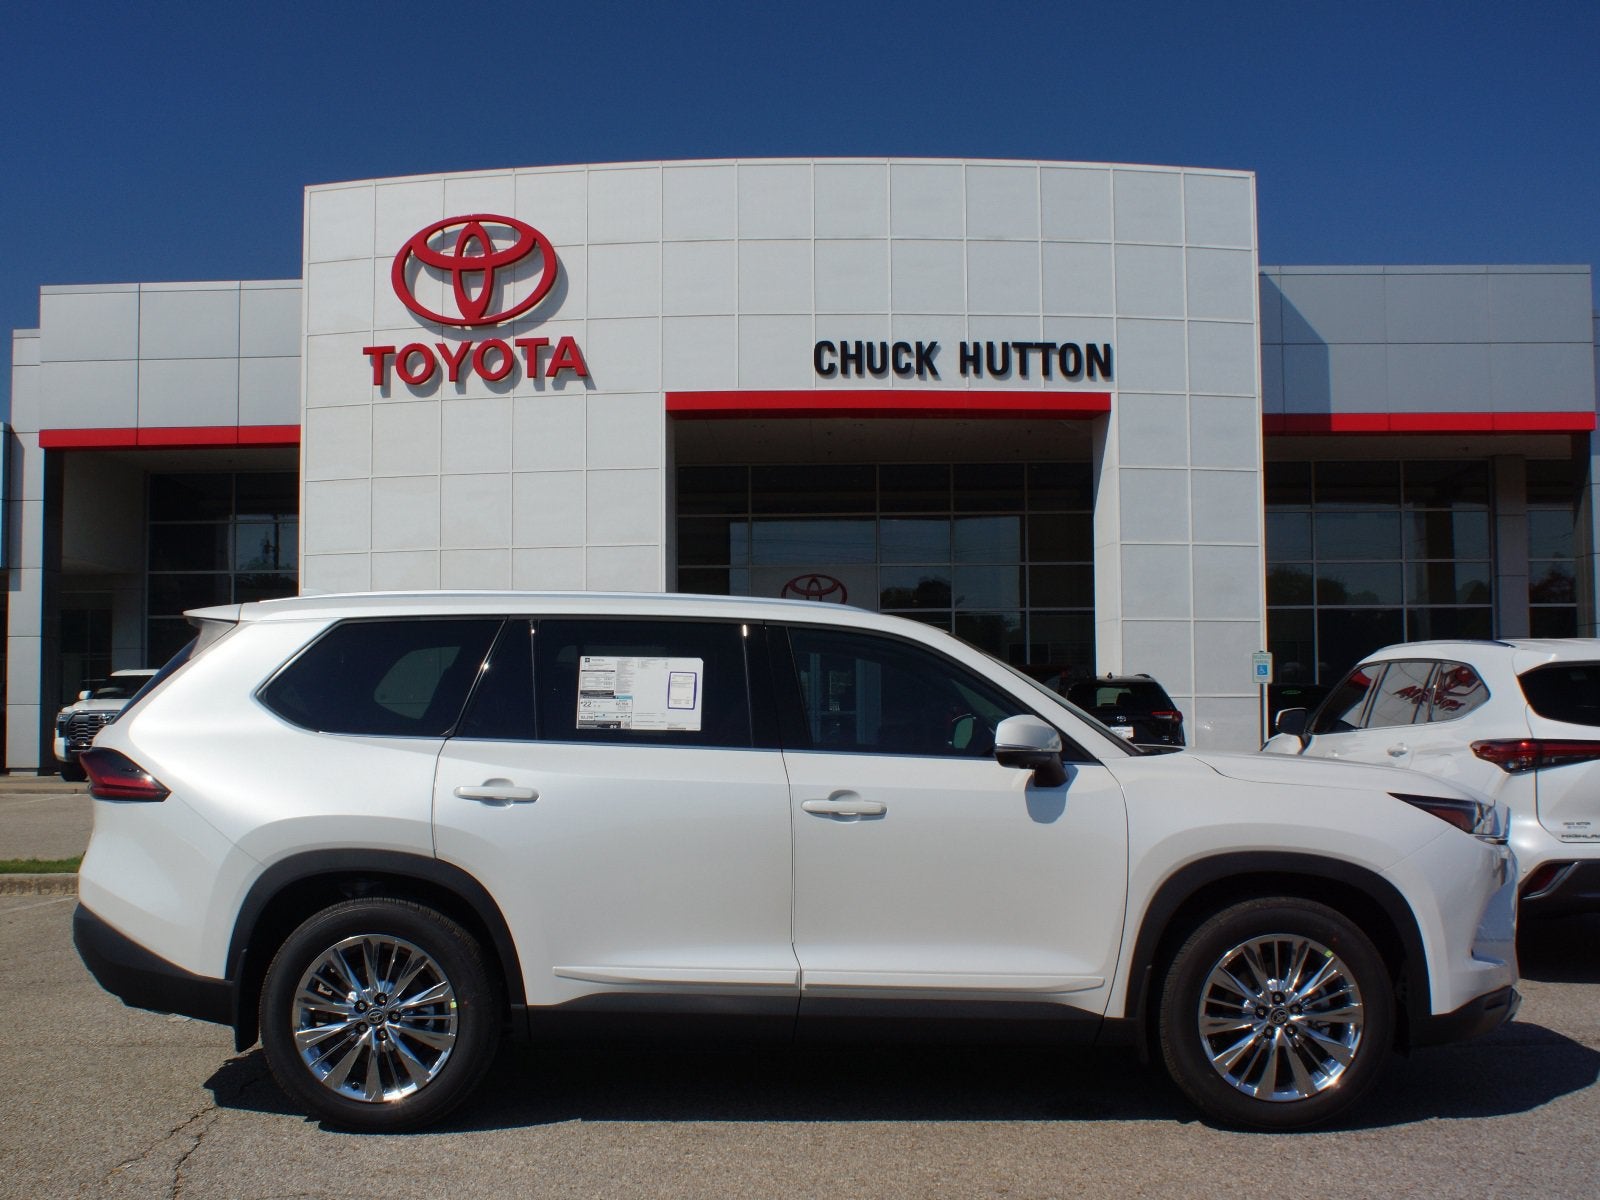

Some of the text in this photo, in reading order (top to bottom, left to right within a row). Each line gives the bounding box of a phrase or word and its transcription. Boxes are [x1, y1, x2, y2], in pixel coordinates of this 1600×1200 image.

[363, 336, 588, 386] TOYOTA
[813, 340, 1112, 378] CHUCK HUTTON
